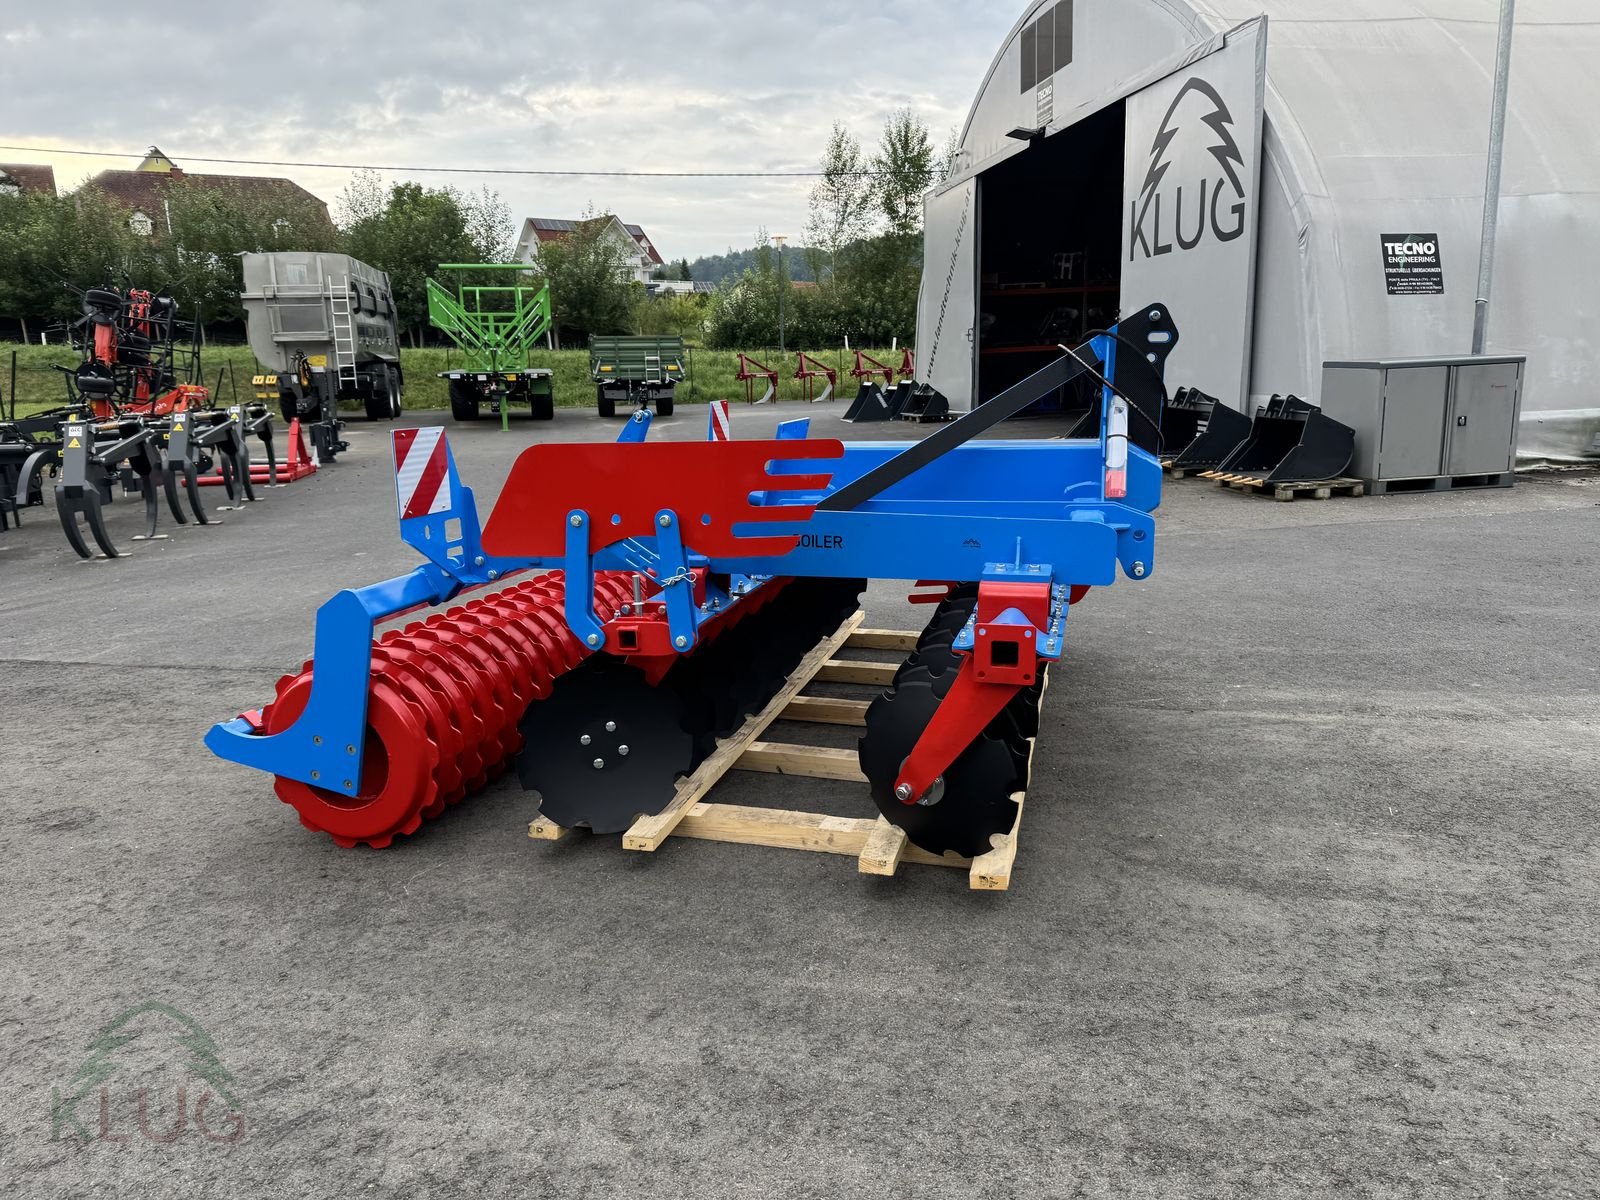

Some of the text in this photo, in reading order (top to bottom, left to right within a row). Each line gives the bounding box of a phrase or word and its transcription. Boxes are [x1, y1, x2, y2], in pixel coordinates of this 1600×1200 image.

[1130, 177, 1245, 261] KLUG
[1384, 243, 1435, 254] TECNO
[926, 186, 971, 378] www.landtechnik-klug.at
